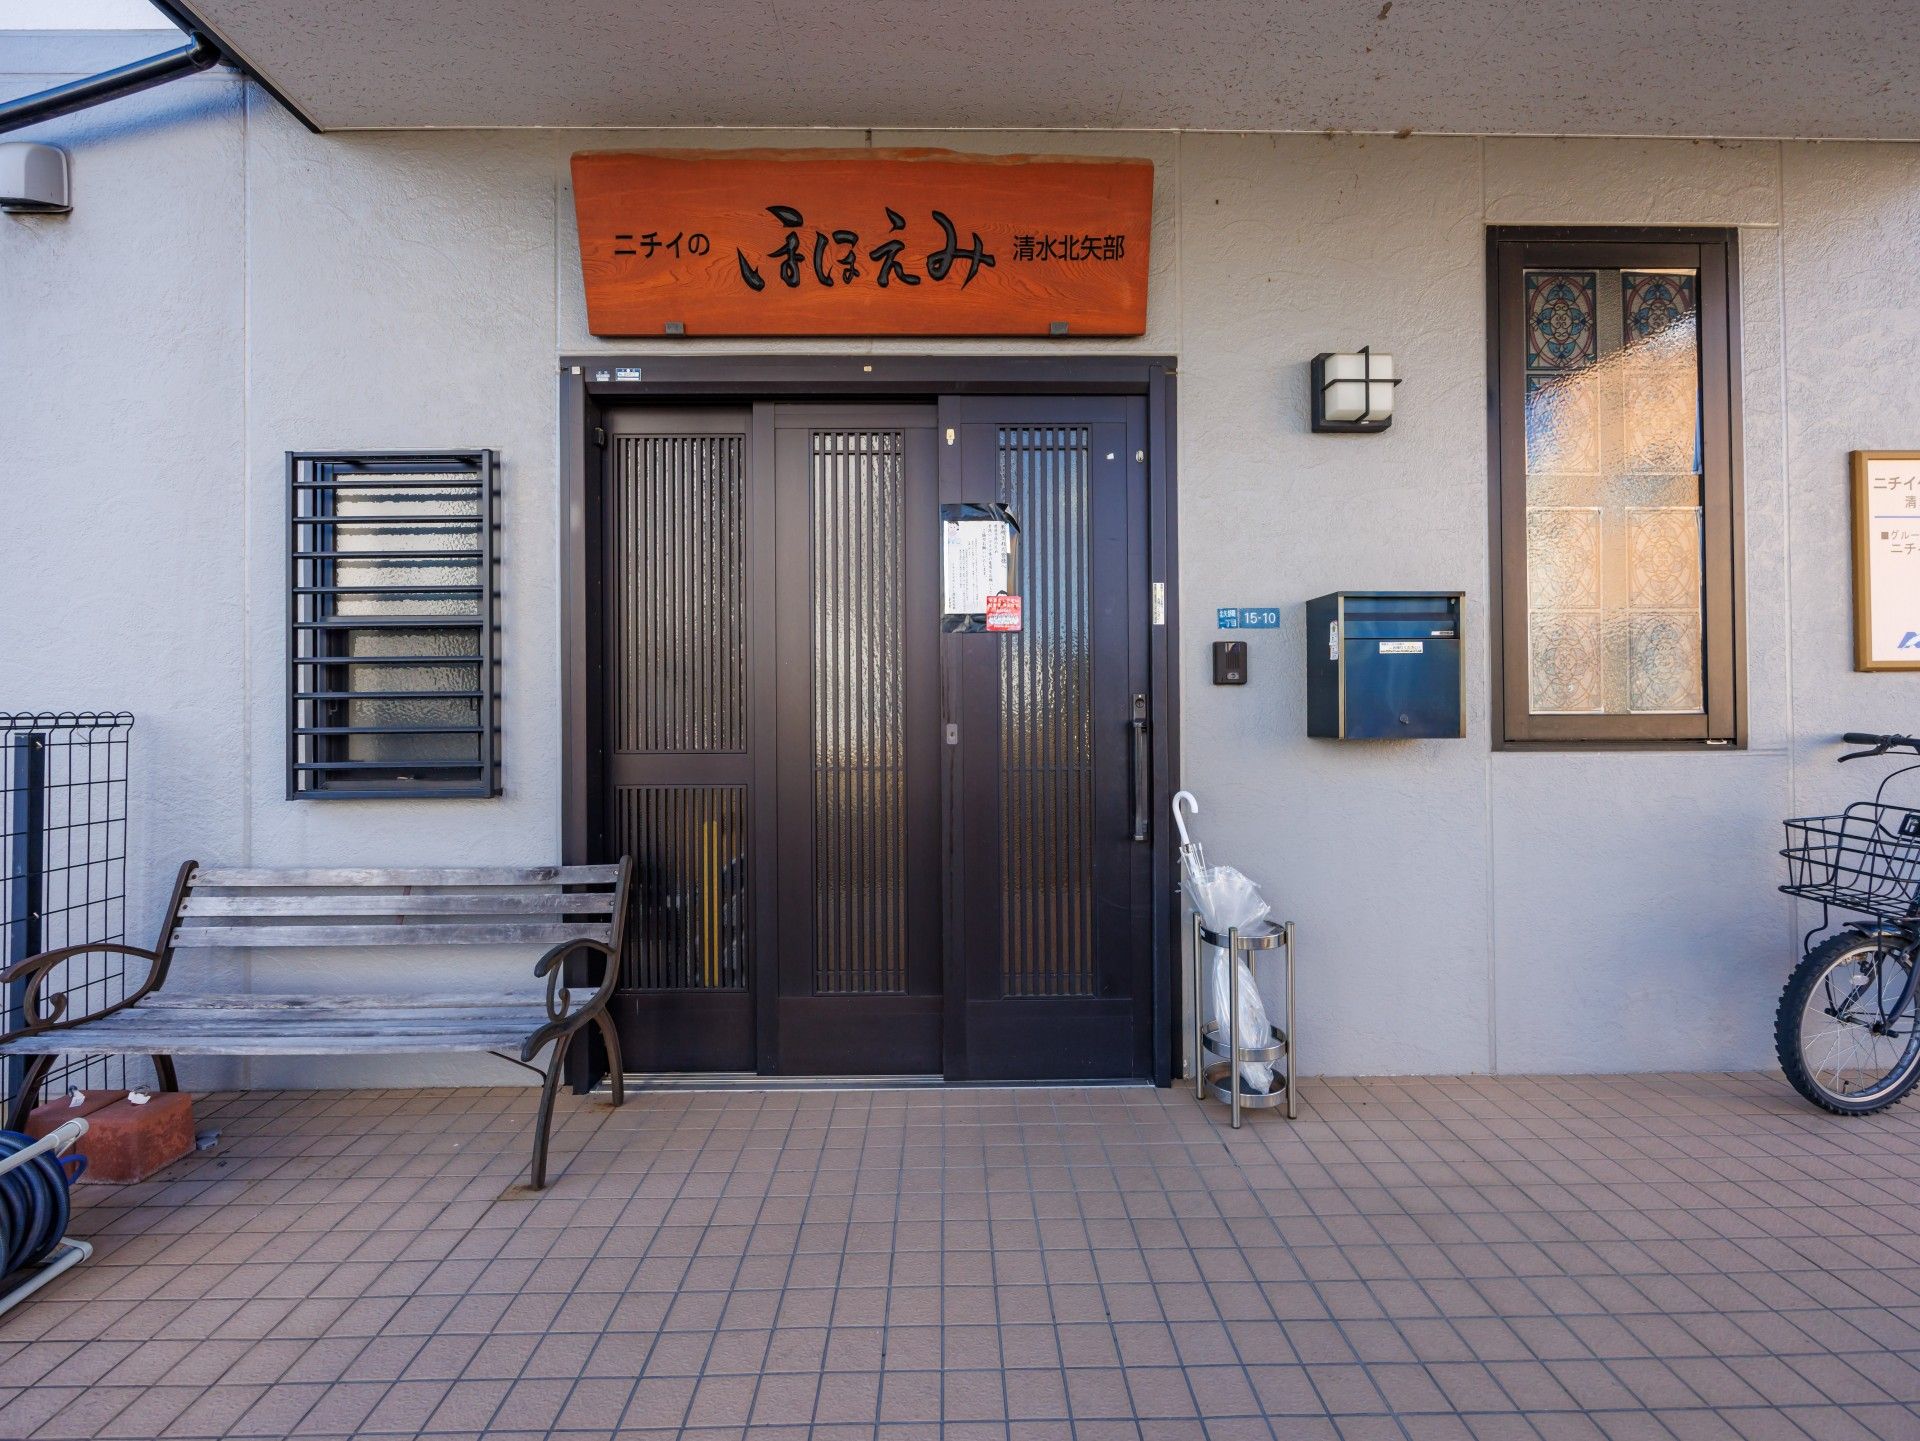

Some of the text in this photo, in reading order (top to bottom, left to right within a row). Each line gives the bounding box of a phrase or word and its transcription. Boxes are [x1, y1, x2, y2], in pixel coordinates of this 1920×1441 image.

[614, 231, 710, 258] ニチイの
[1012, 234, 1126, 261] 清水北矢部
[1905, 495, 1920, 509] 清
[1891, 543, 1920, 555] ニチ
[1244, 612, 1276, 624] 15-10
